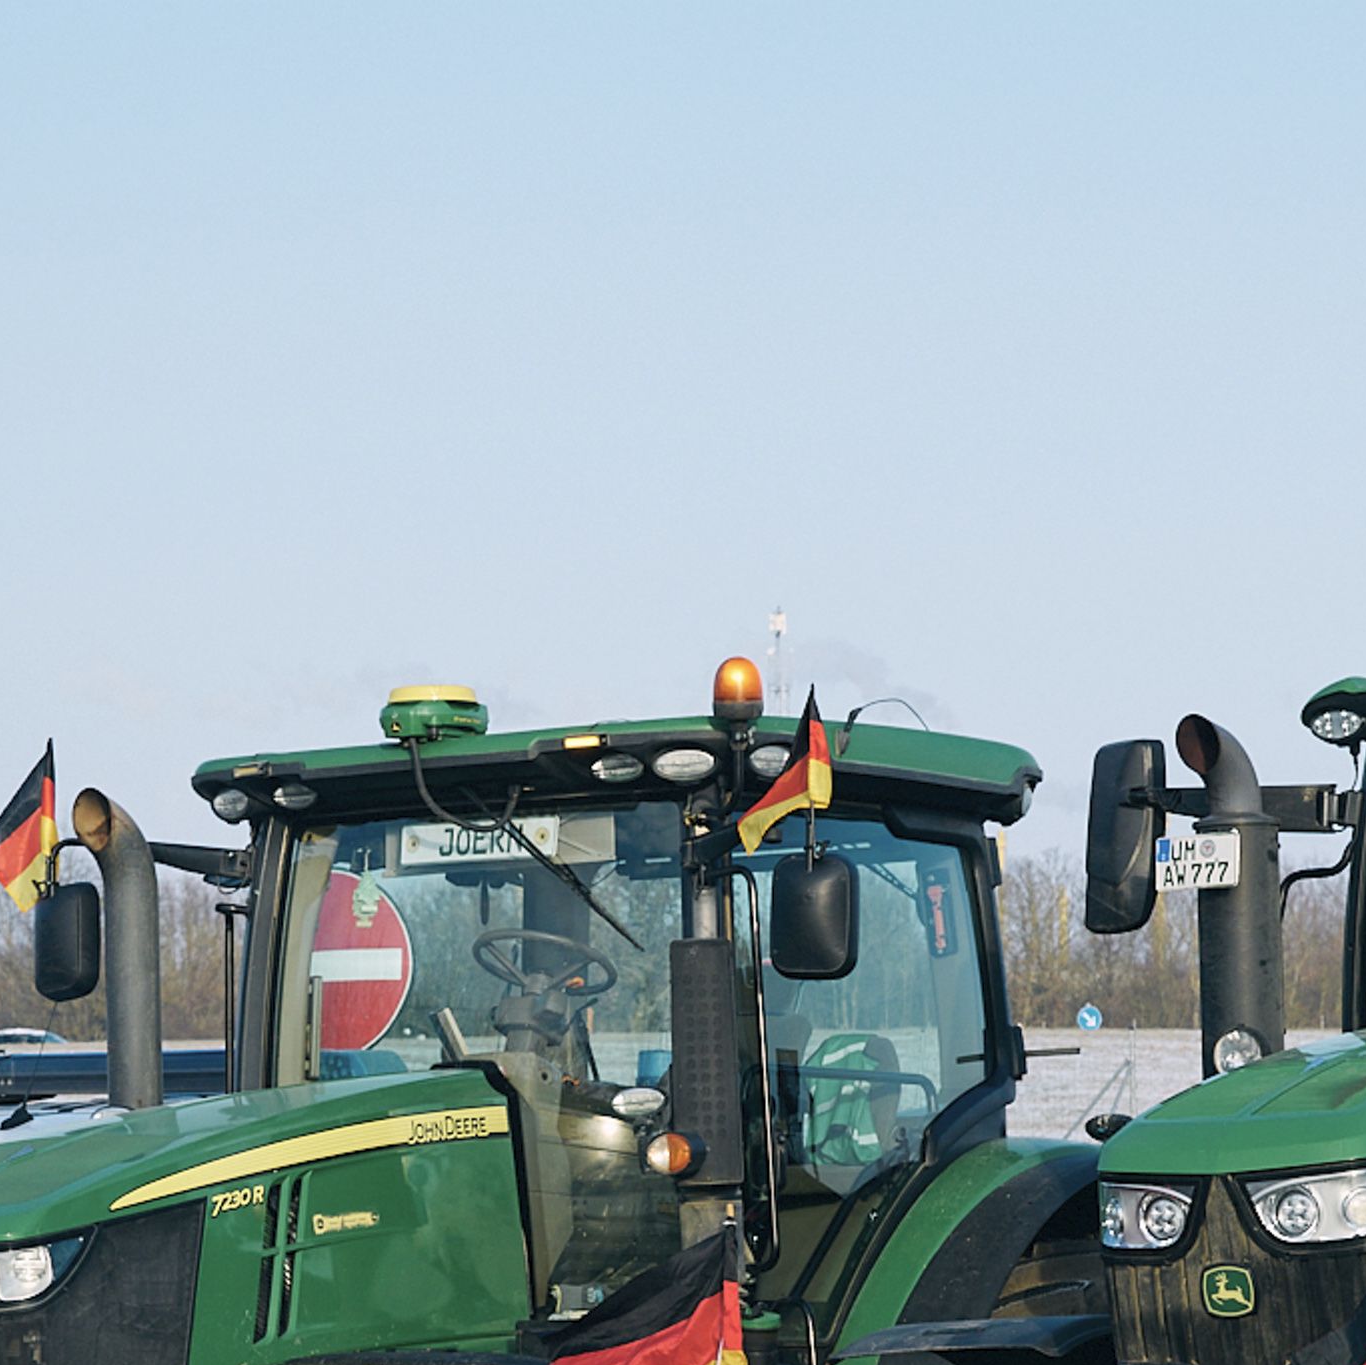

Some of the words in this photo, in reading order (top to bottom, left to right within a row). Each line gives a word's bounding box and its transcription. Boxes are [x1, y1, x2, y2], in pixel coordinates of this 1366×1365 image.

[439, 825, 523, 856] JOERN
[1171, 840, 1195, 861] UM
[1163, 863, 1186, 887] AW
[1191, 861, 1229, 884] 777
[407, 1119, 443, 1144] JOHN
[444, 1115, 488, 1136] DEERE
[210, 1187, 252, 1218] 7230
